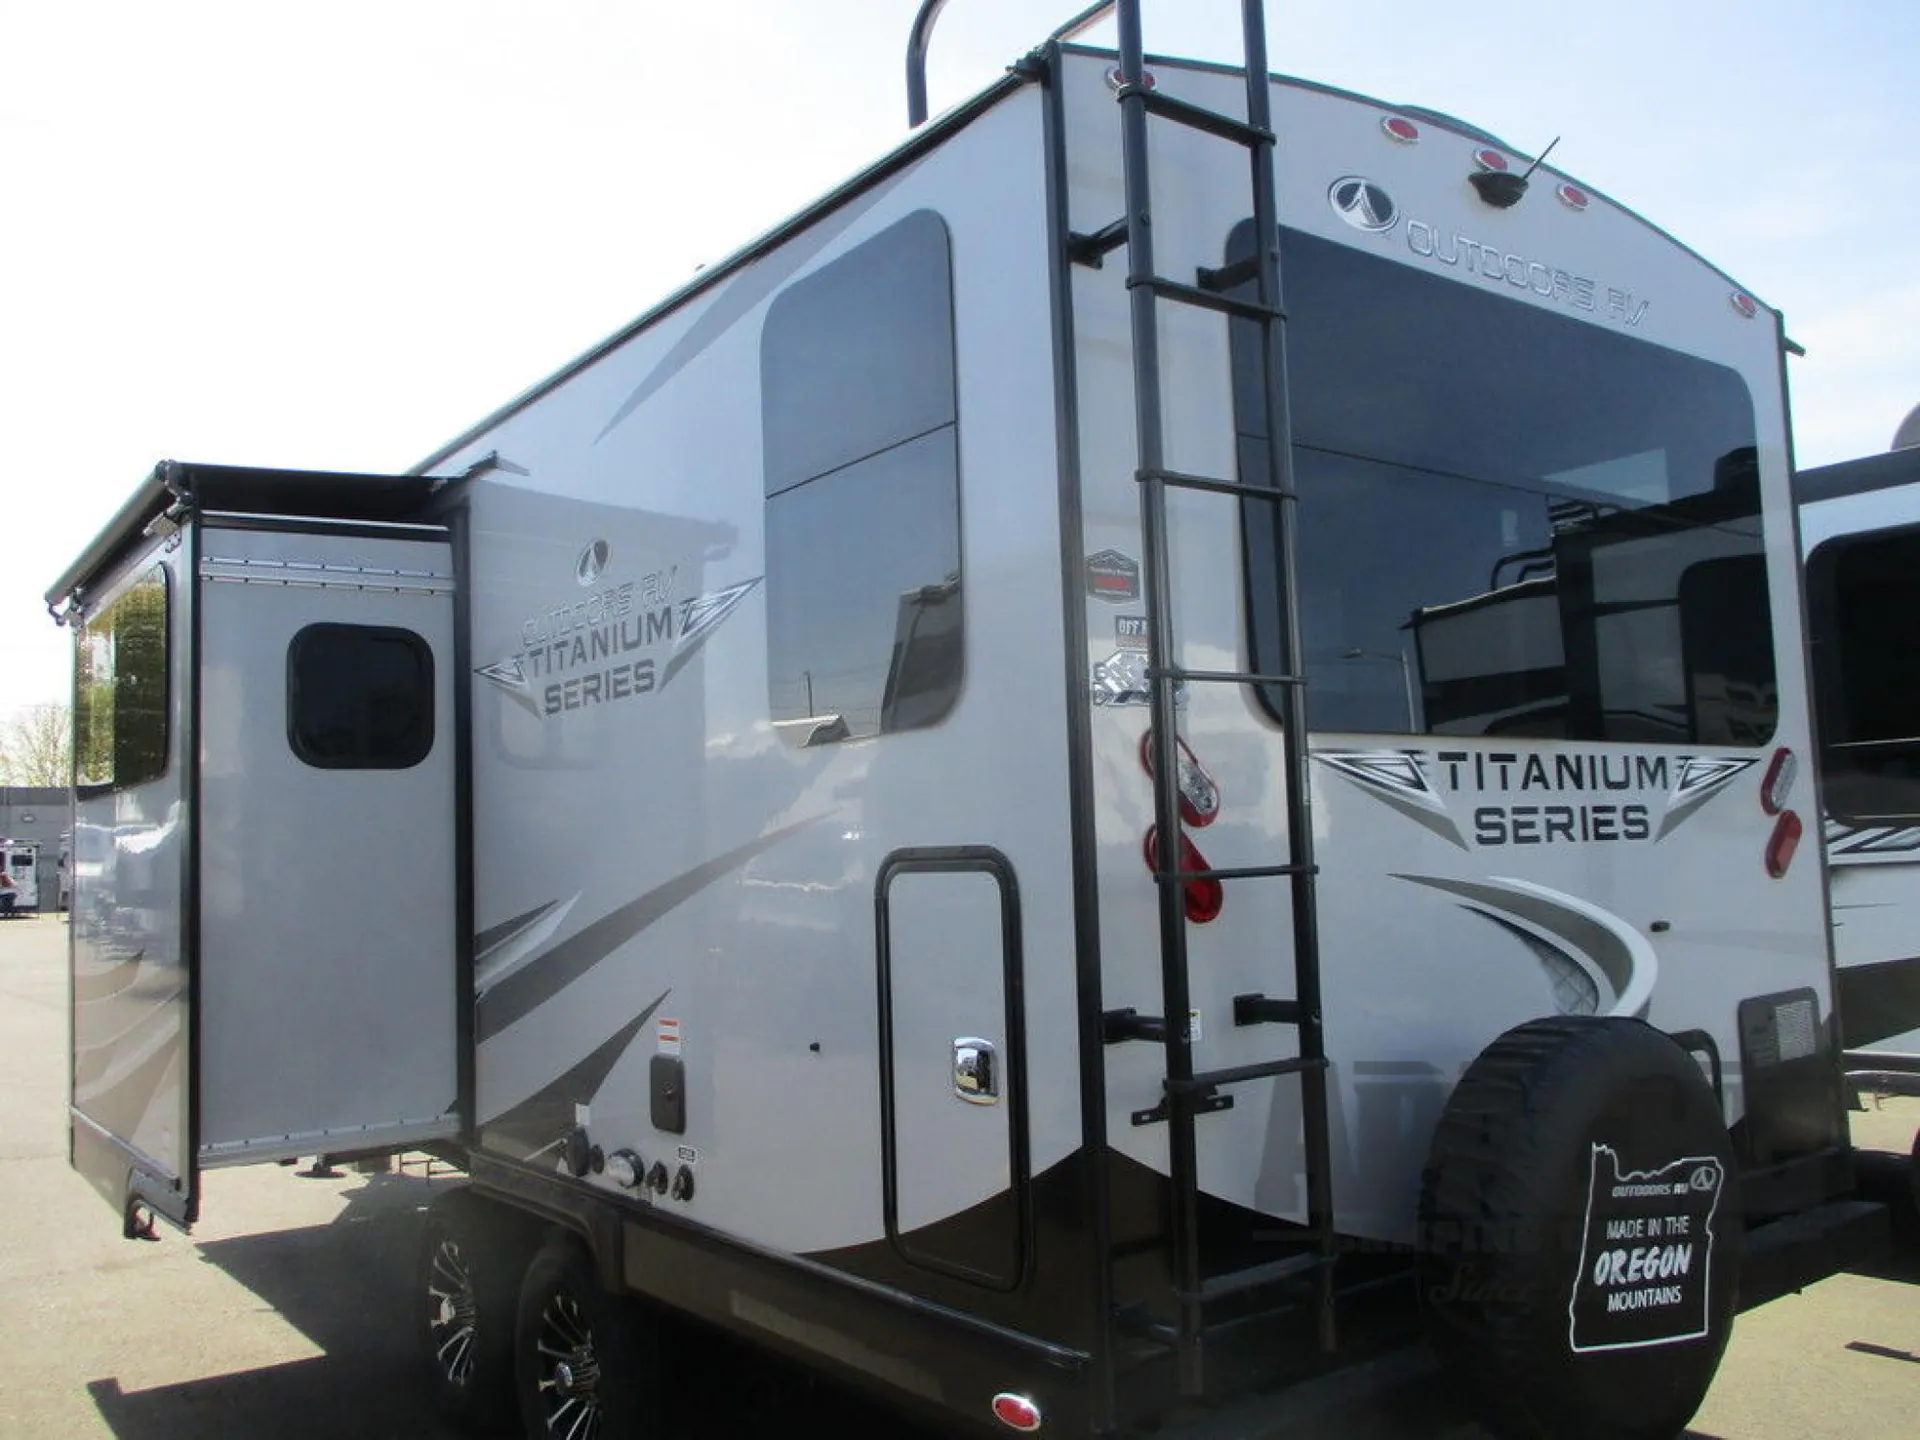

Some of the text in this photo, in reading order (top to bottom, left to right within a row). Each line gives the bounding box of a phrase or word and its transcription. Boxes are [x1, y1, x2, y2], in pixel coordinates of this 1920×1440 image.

[1405, 218, 1650, 328] OUTDOORS RV
[527, 605, 673, 678] TITANIUM
[543, 657, 656, 716] SERIES
[1437, 750, 1669, 792] TITANIUM
[1473, 804, 1650, 846] SERIES
[1611, 1183, 1671, 1198] OUTDOORS
[1606, 1214, 1691, 1240] MADE IN THE
[1592, 1243, 1693, 1287] OREGON
[1606, 1285, 1683, 1314] MOUNTAINS
